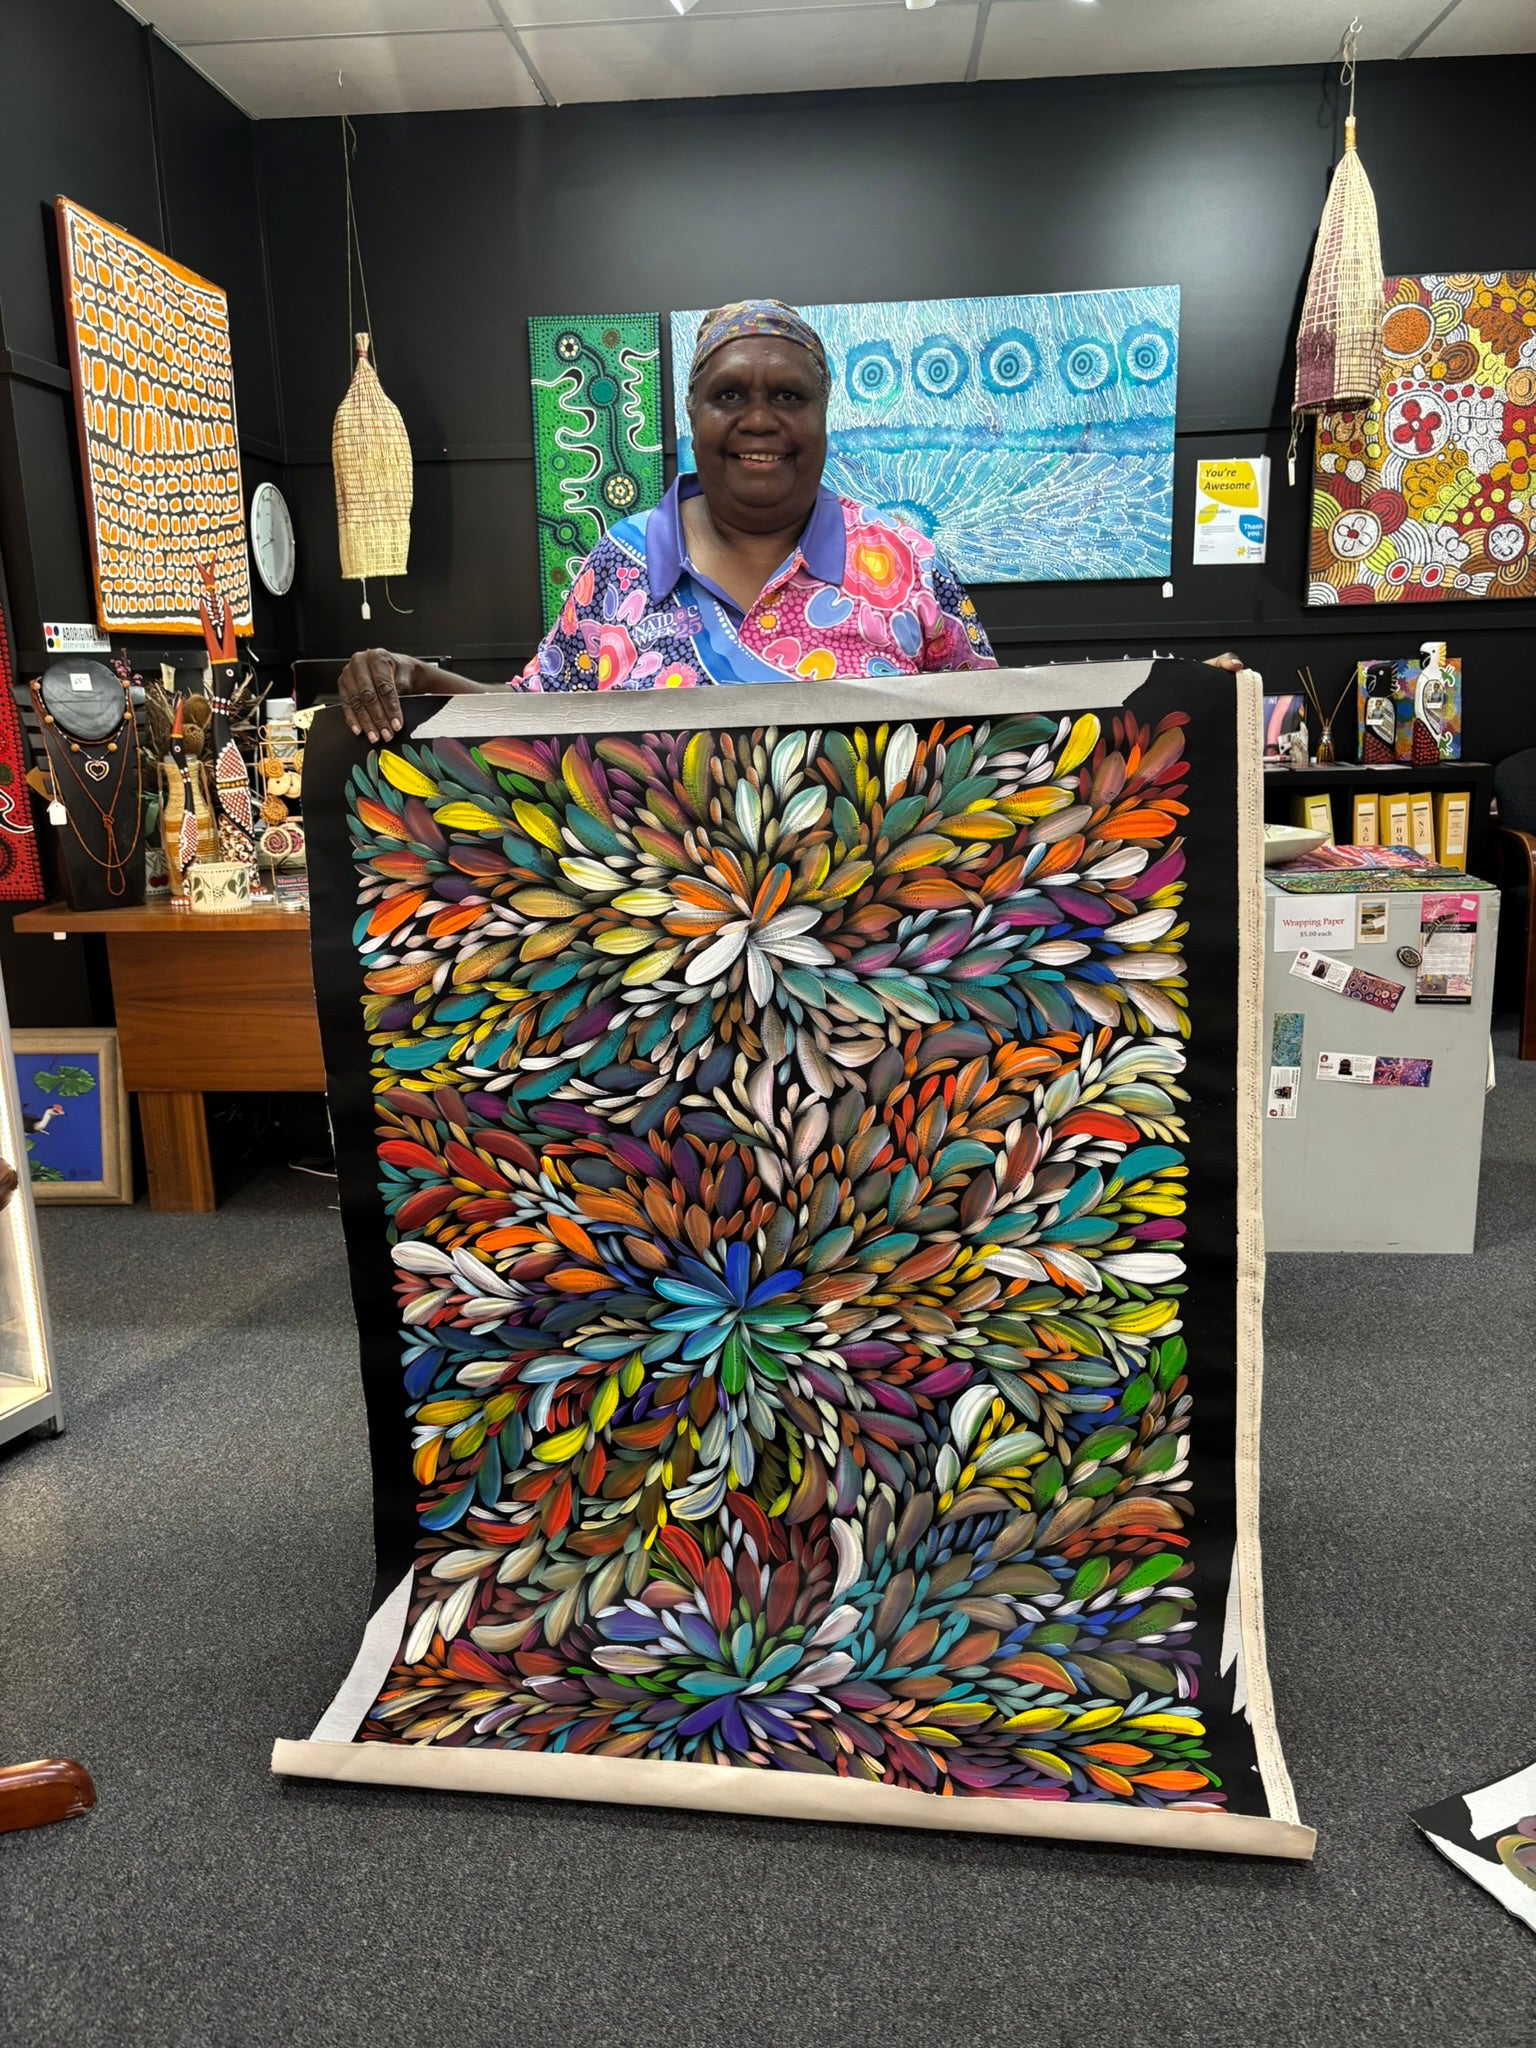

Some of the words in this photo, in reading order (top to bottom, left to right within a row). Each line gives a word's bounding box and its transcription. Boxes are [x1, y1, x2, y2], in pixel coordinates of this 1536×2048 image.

[1205, 468, 1237, 478] You're
[1204, 481, 1251, 491] Awesome
[62, 626, 97, 641] ABORIGINAL
[632, 623, 678, 646] WEEK
[1282, 919, 1322, 928] Wrapping
[1323, 917, 1346, 927] Paper
[1299, 930, 1317, 938] $5.00
